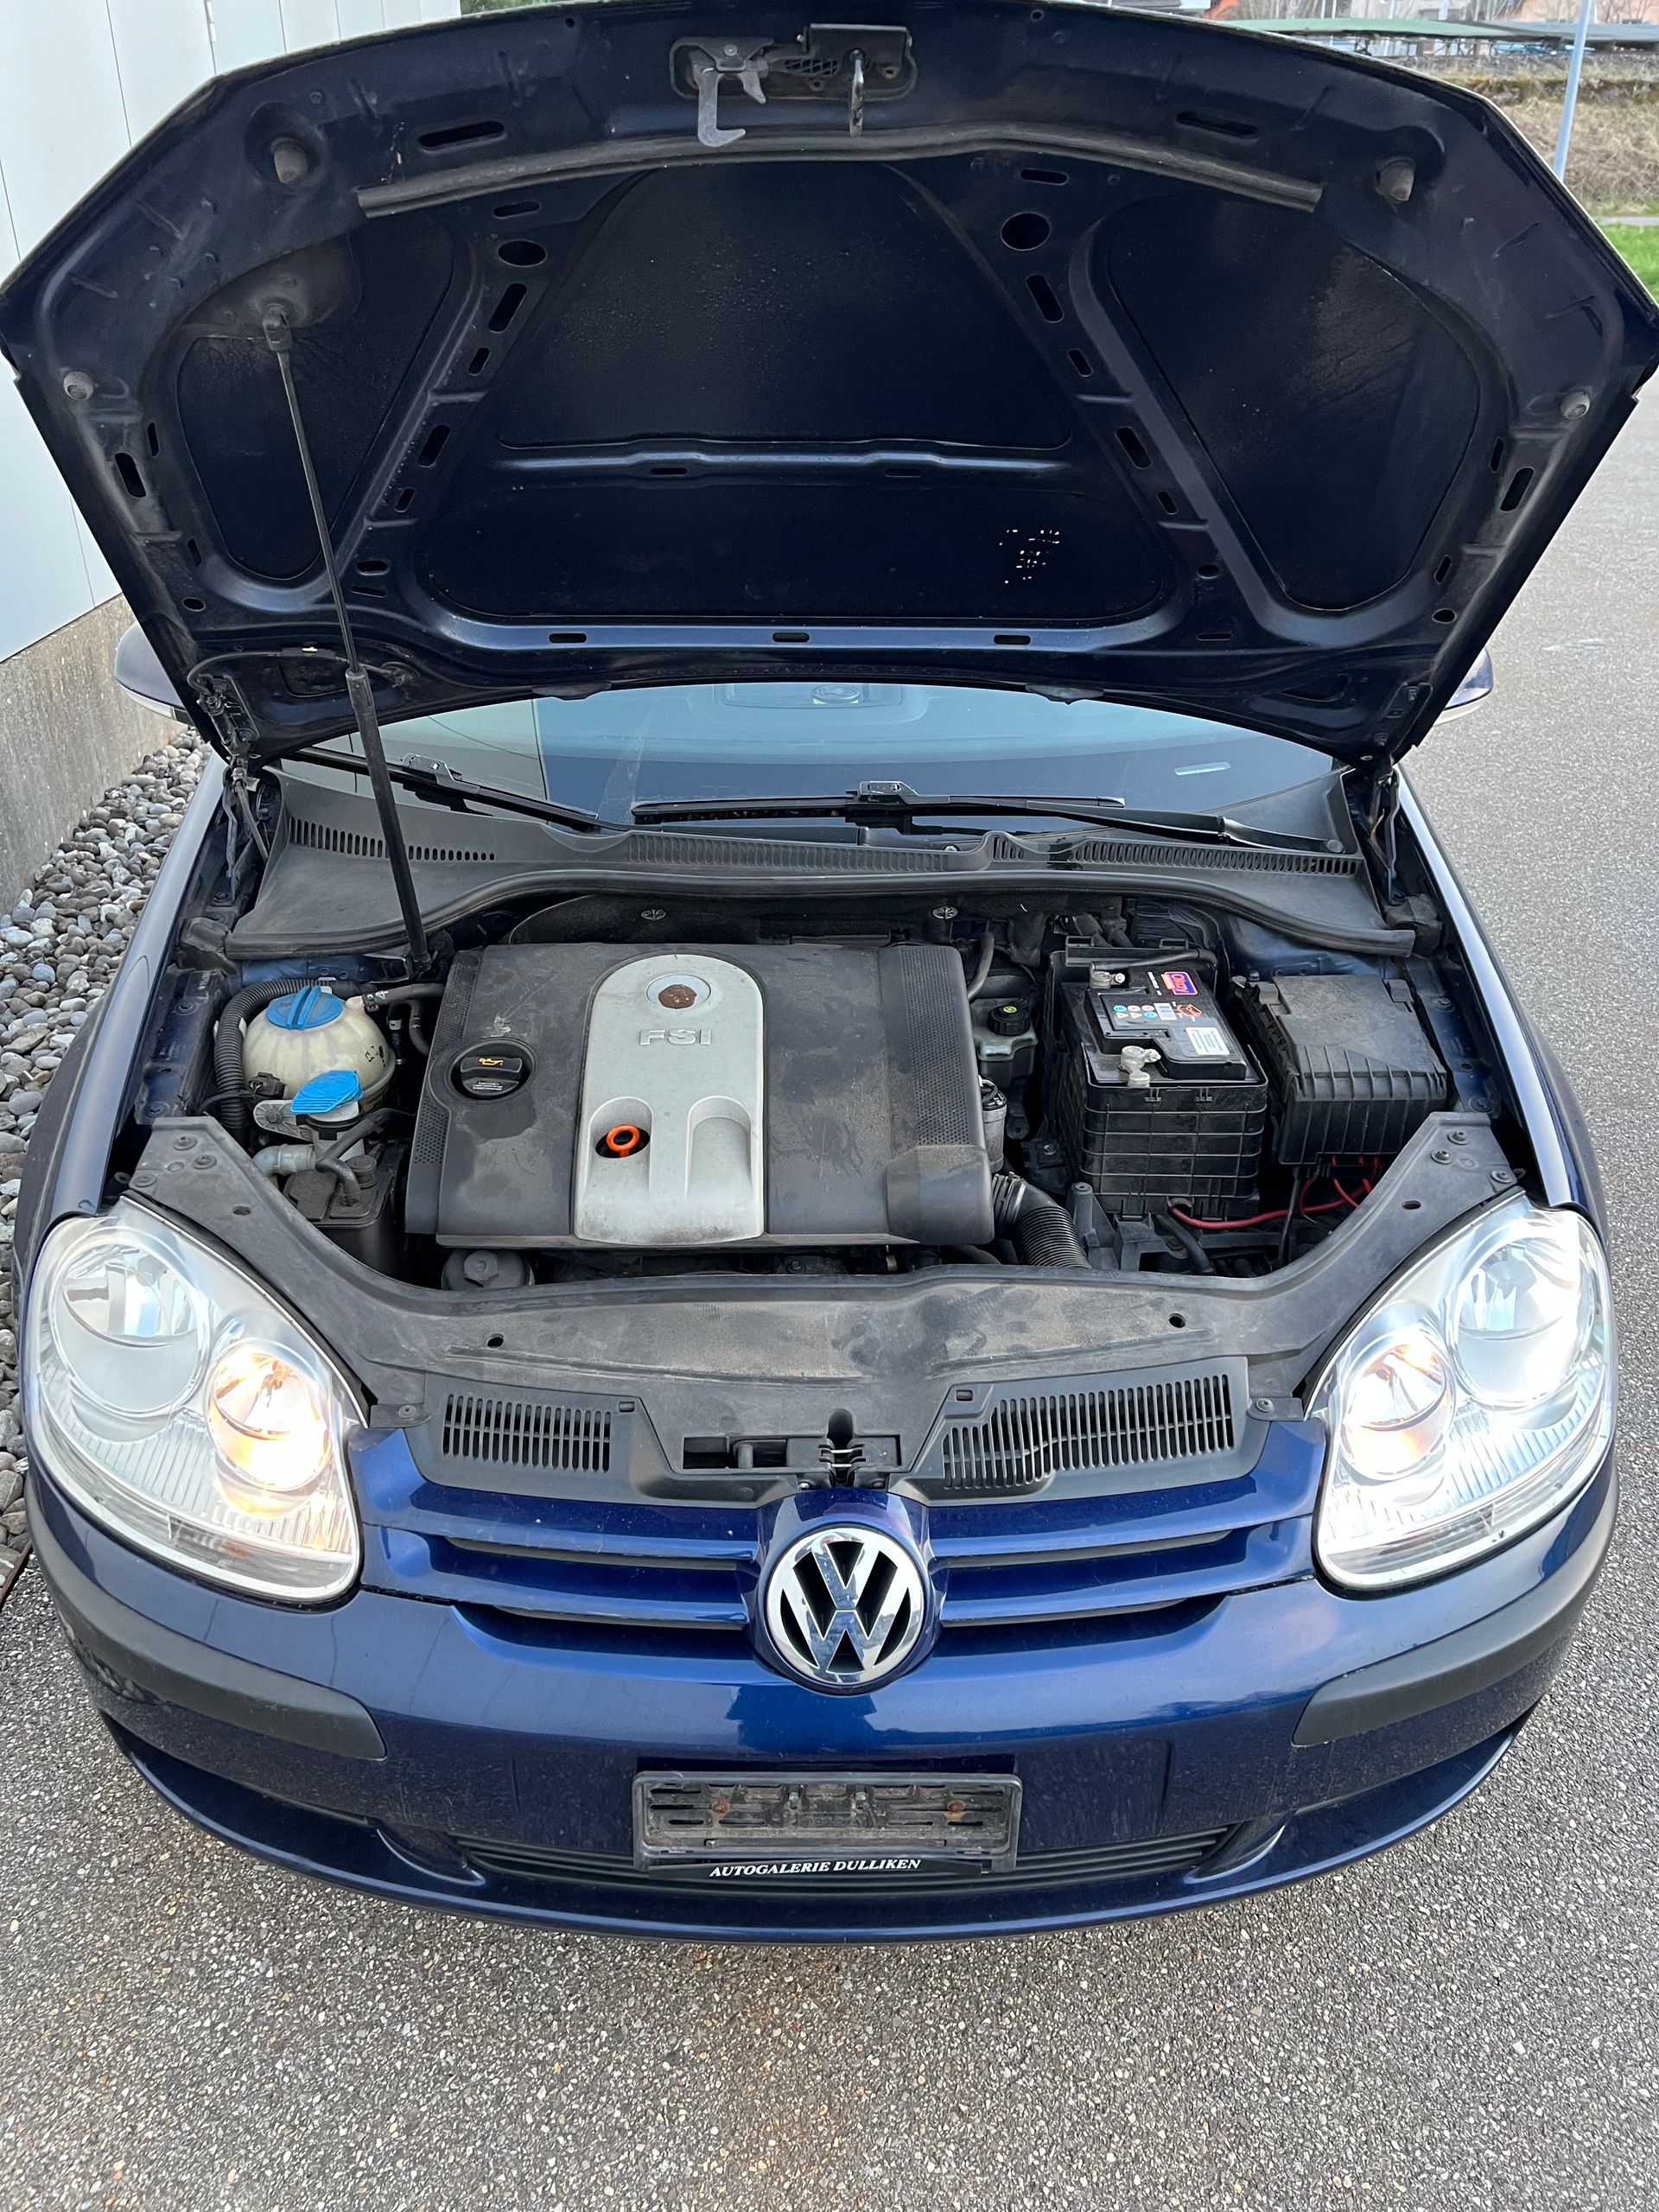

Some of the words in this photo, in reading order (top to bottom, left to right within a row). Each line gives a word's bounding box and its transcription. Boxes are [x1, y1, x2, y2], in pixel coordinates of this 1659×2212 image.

[639, 1029, 711, 1046] FSI
[767, 1528, 924, 1683] VW
[709, 1861, 830, 1877] AUTOGALERIE
[833, 1859, 921, 1872] DULLIKEN
